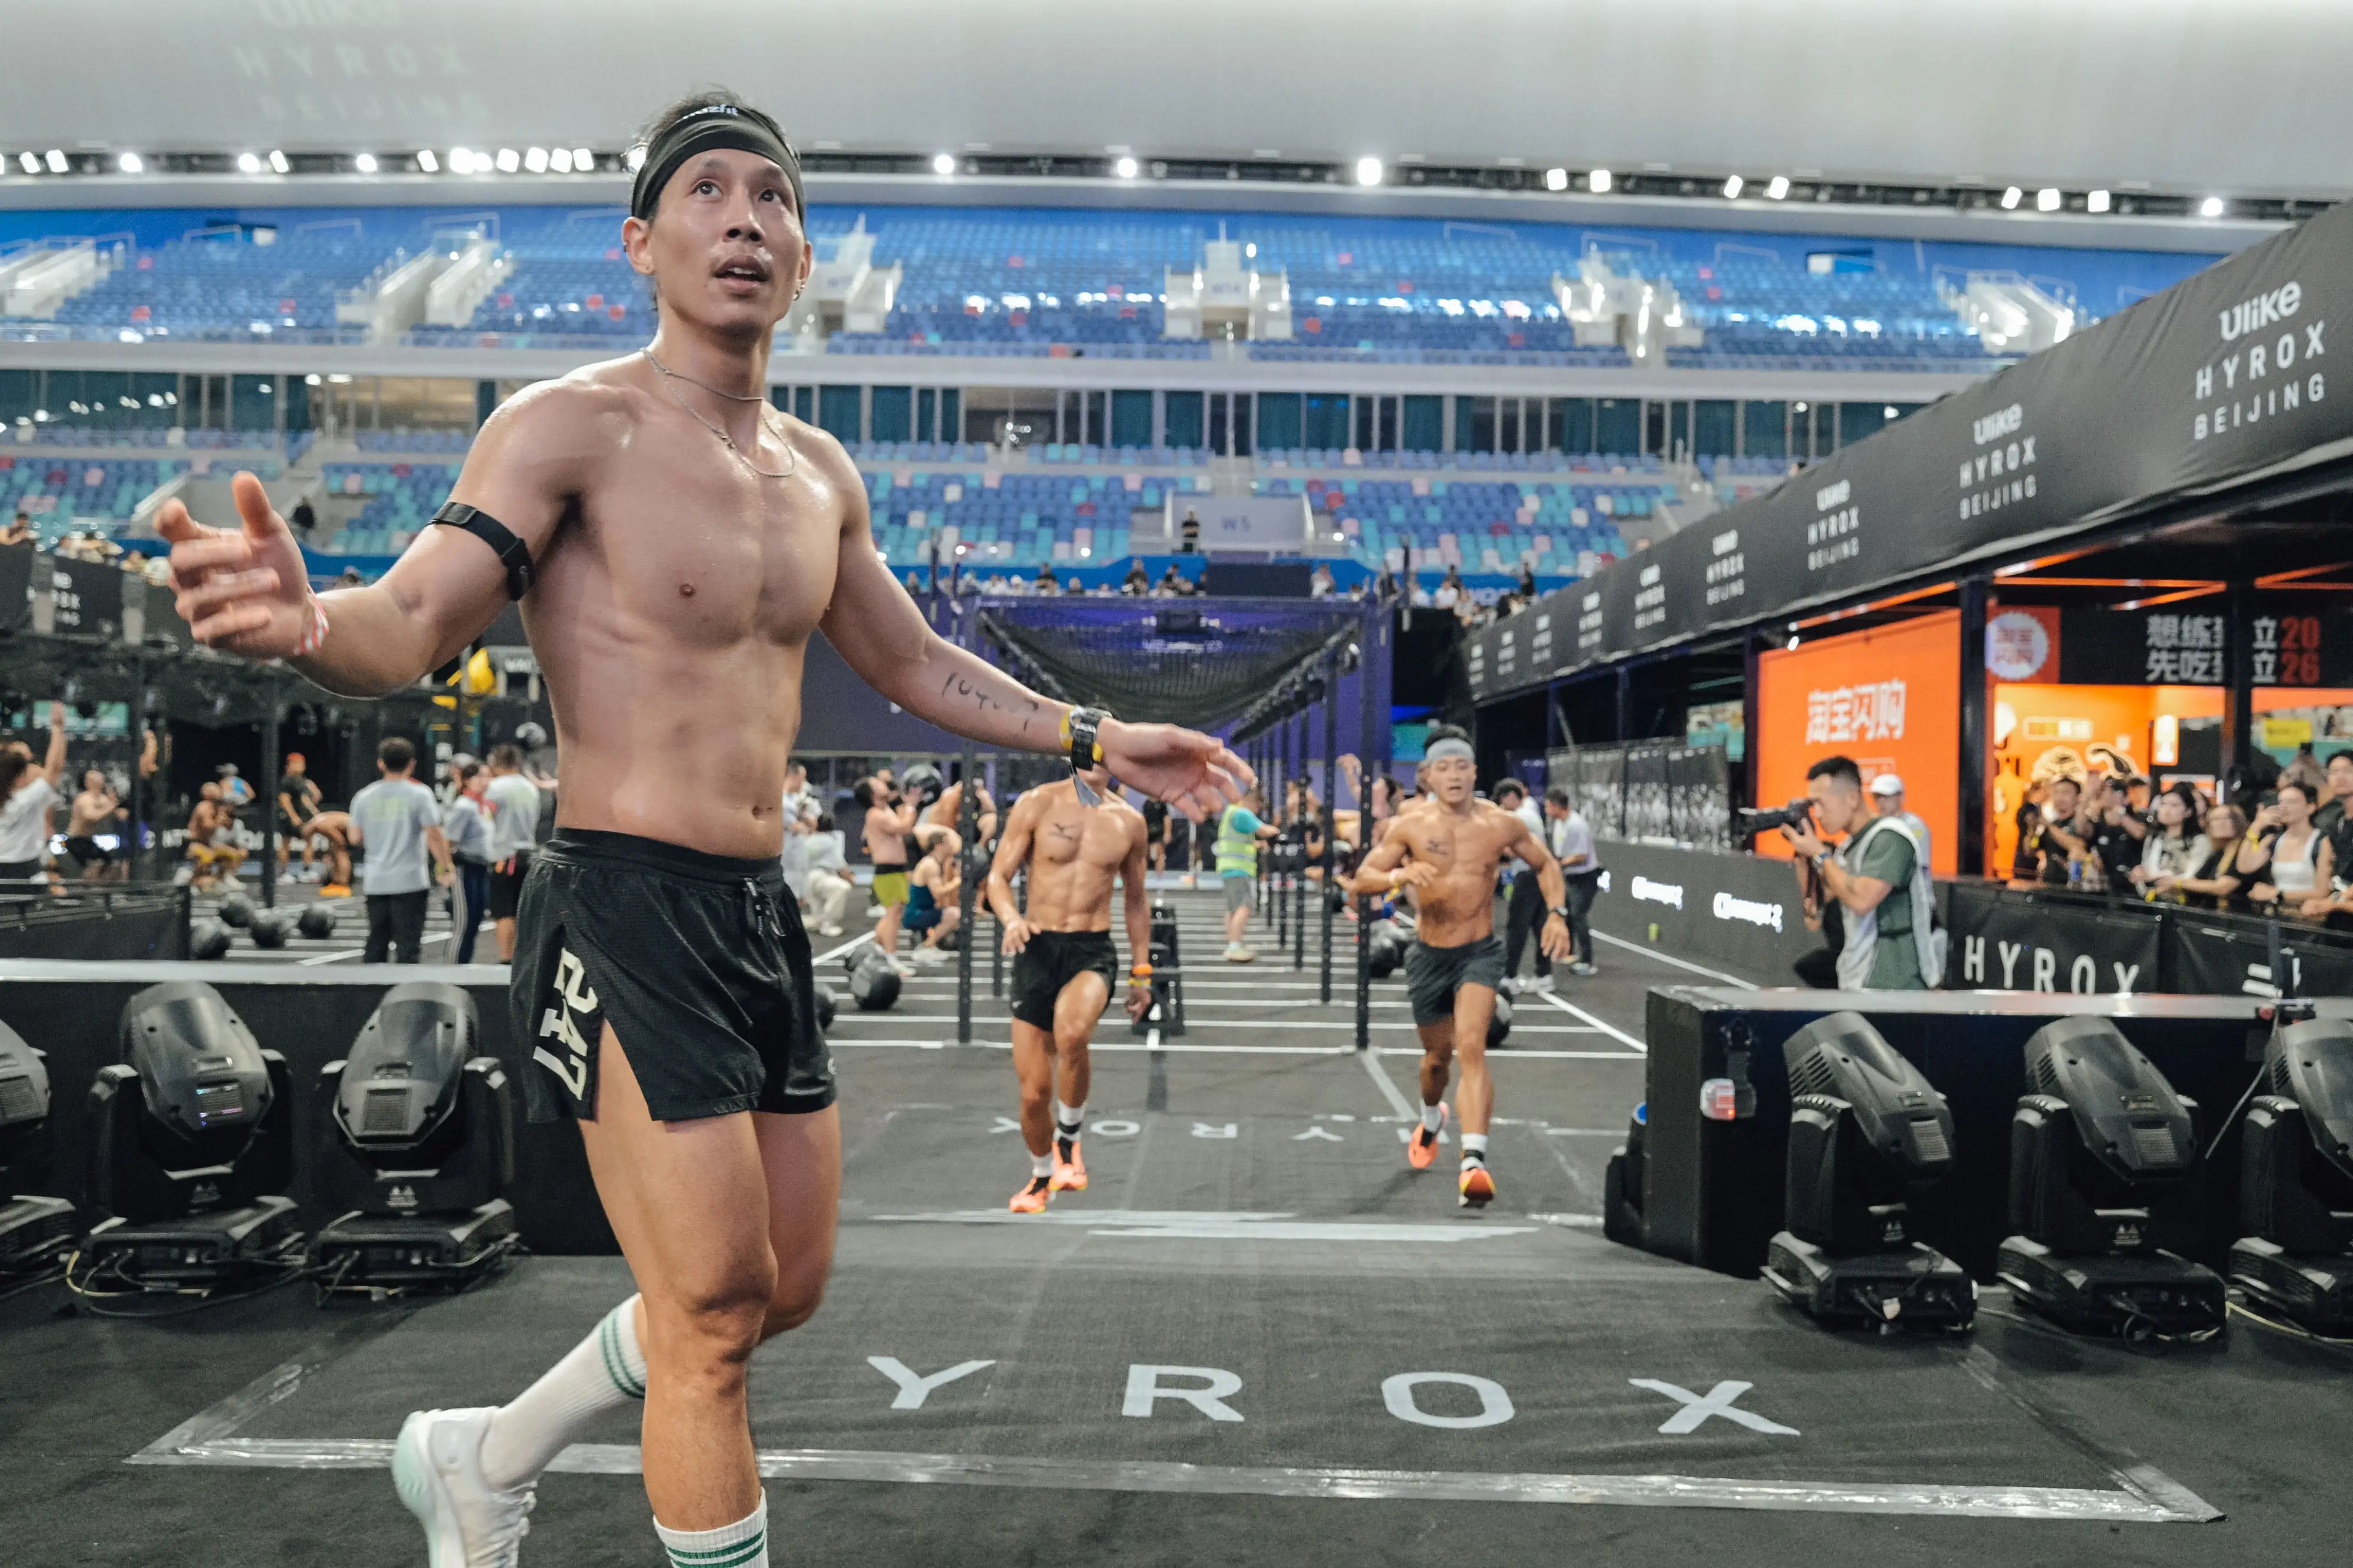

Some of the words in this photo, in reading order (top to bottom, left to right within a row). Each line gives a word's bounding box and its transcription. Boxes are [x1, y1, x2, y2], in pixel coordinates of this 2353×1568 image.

[2219, 281, 2301, 341] Ulike
[2196, 319, 2325, 399] HYROX
[2195, 372, 2324, 440] BEIJING
[1959, 435, 2036, 489] HYROX
[1959, 475, 2037, 520] BEIJING
